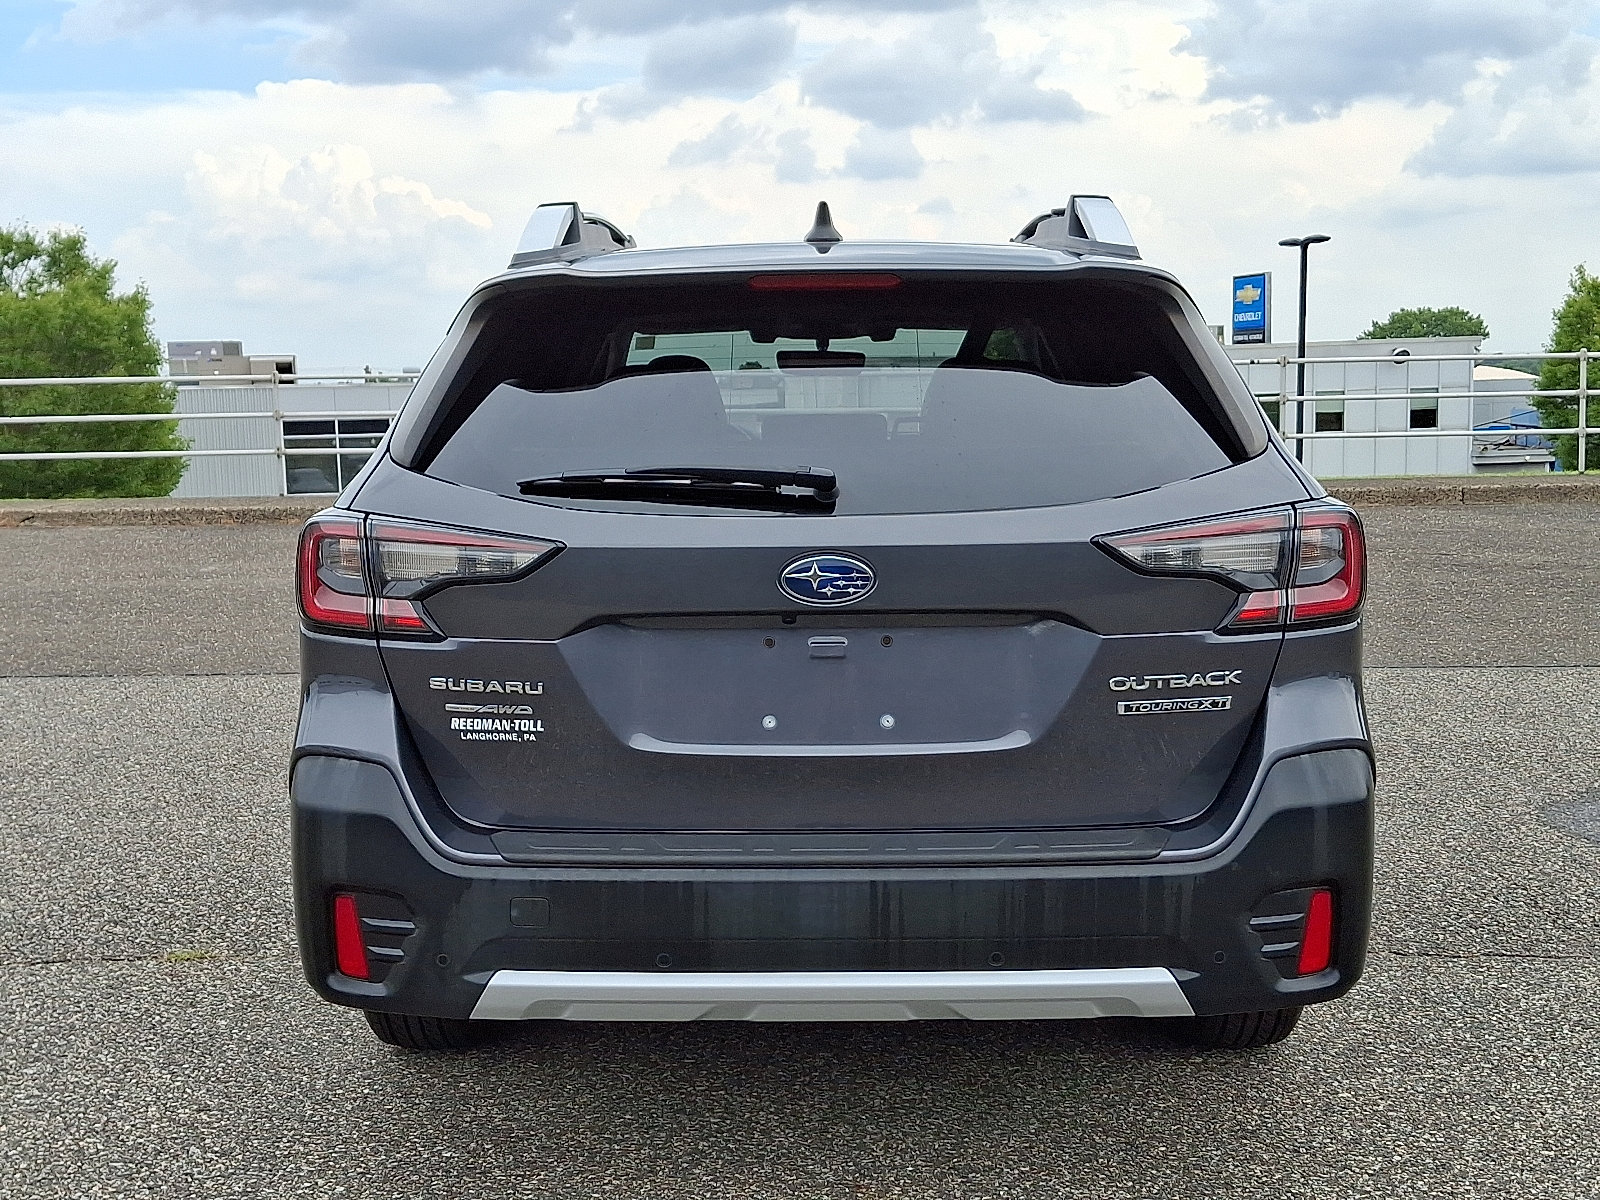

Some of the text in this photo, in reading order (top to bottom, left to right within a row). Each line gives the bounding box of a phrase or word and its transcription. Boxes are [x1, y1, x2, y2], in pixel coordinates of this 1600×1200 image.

[429, 677, 543, 695] SUBARU
[1109, 670, 1242, 691] OUTBACK
[477, 704, 533, 715] AWD
[450, 717, 545, 732] REEDMAN-TOLL
[460, 731, 537, 742] LANGHORNE, PA
